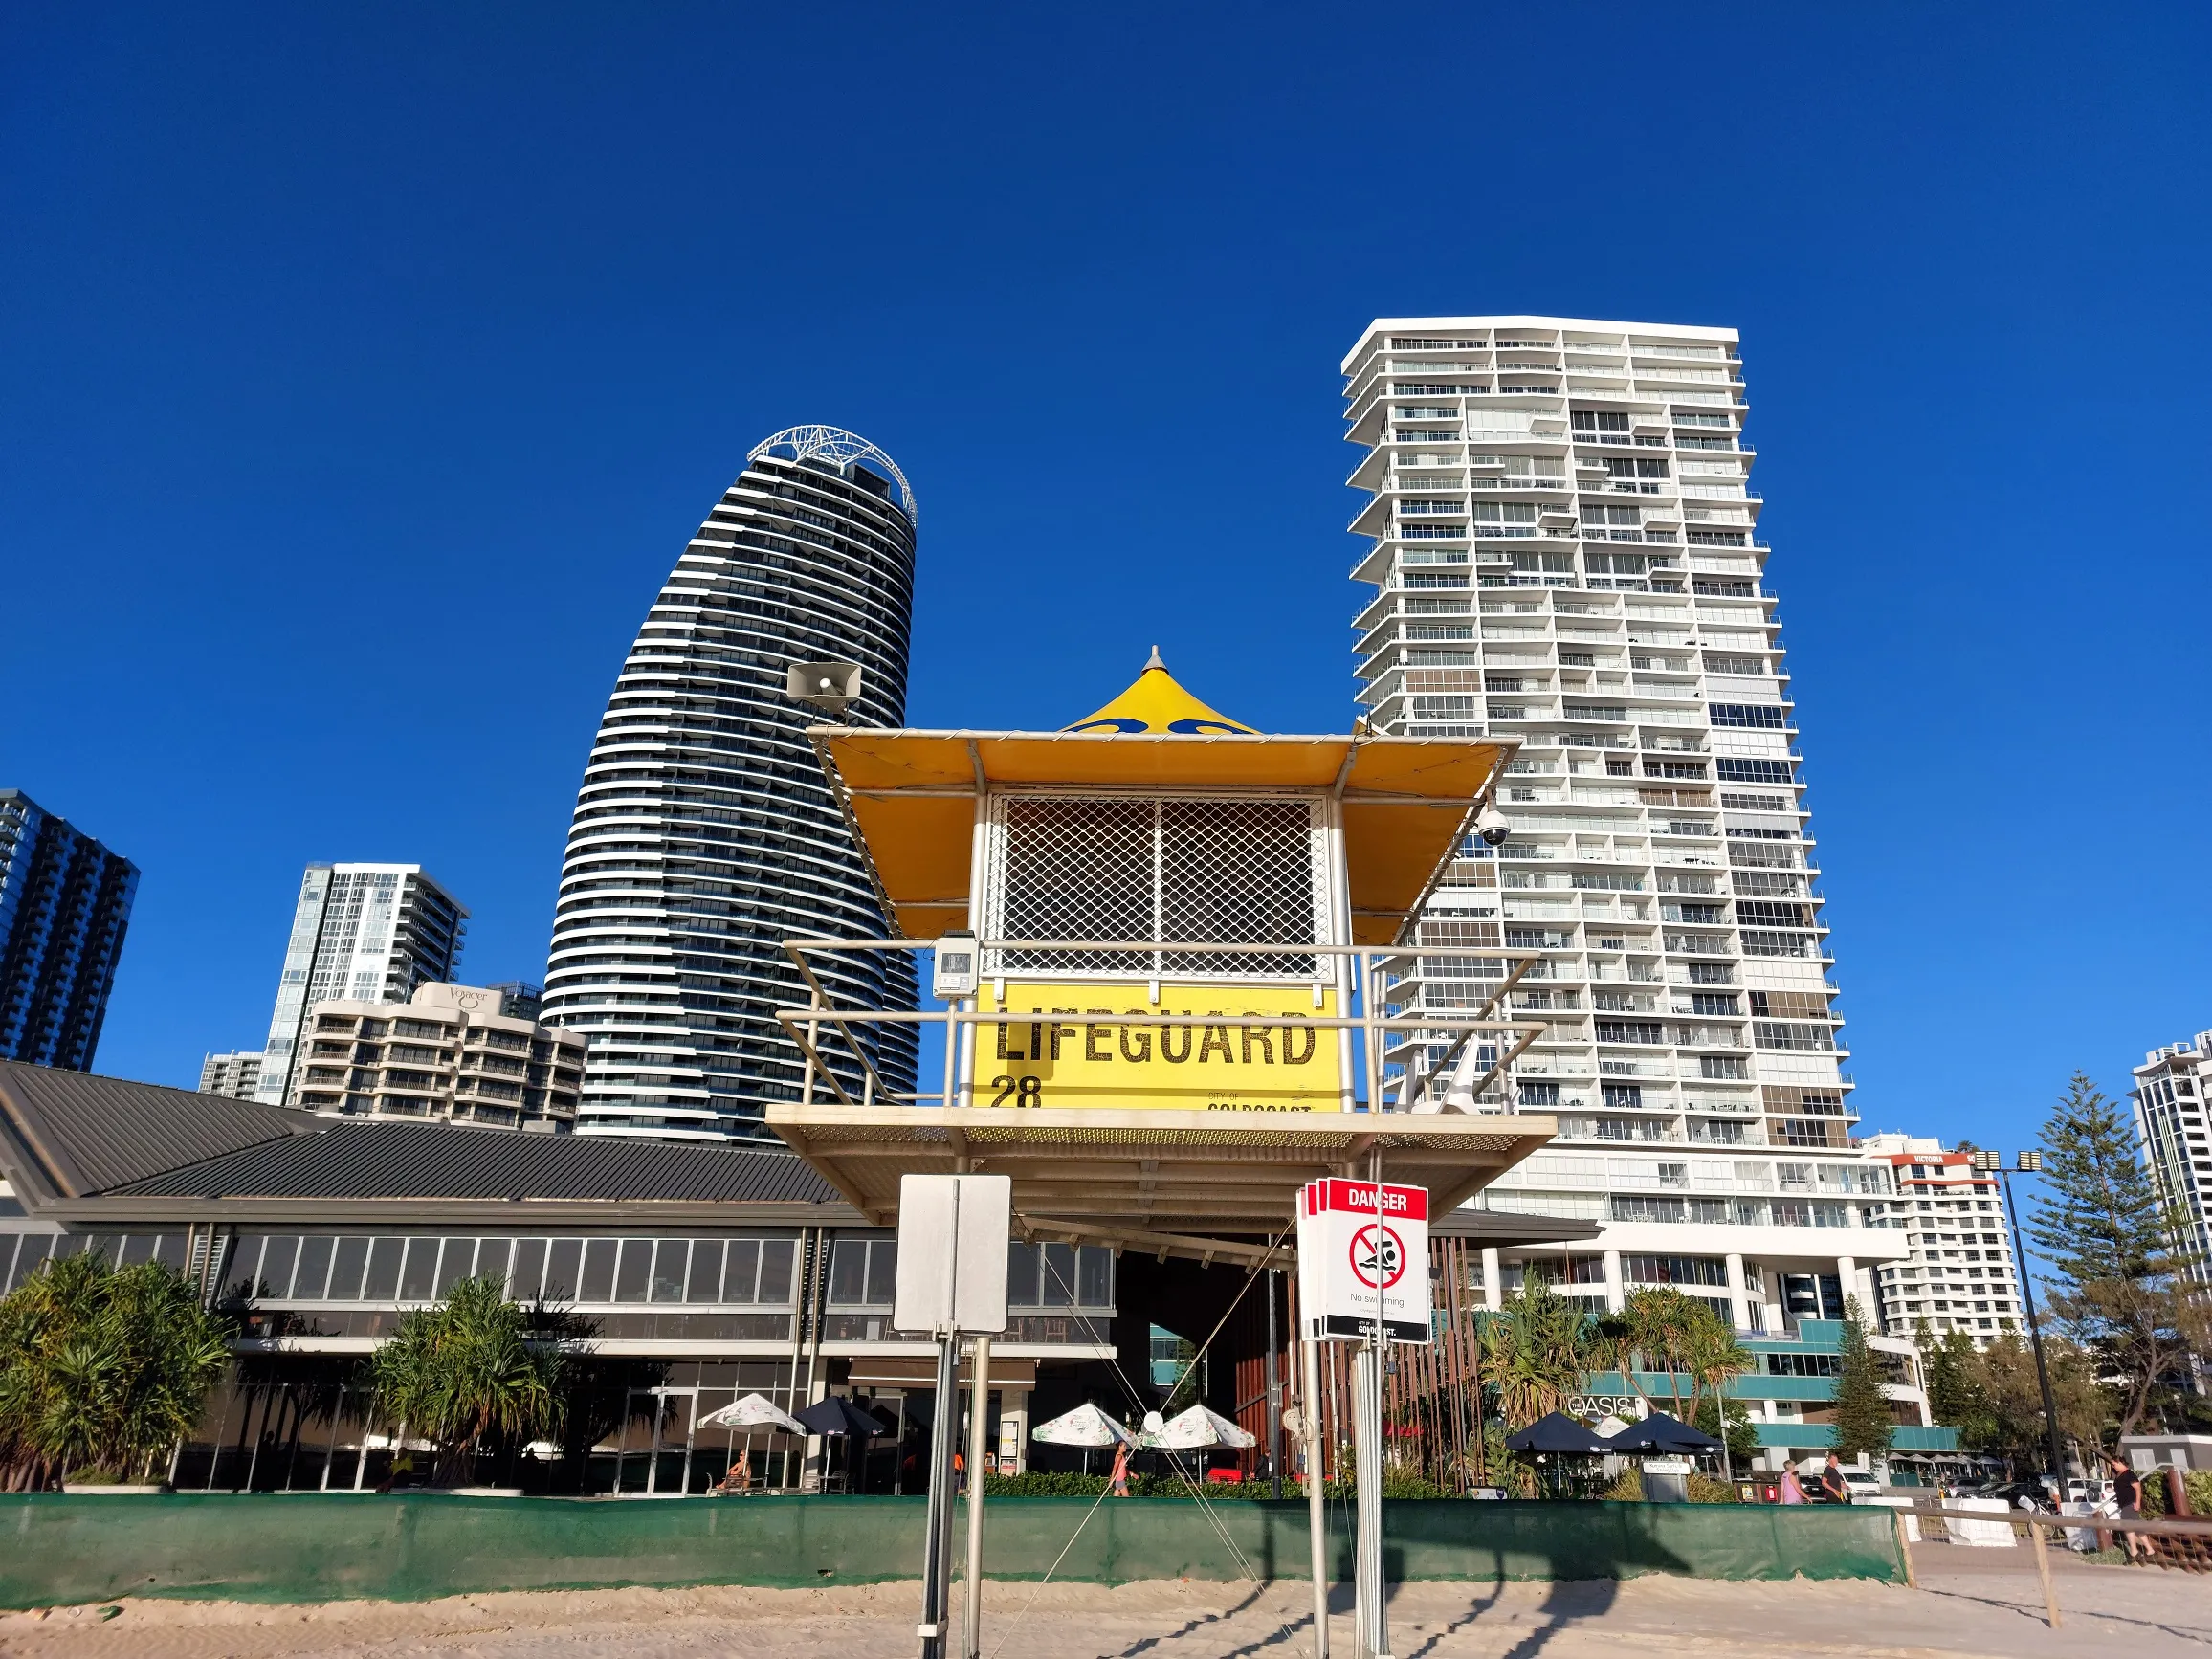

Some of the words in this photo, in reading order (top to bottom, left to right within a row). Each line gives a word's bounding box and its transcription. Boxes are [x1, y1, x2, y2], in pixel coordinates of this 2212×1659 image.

[450, 987, 488, 1009] Voyager
[996, 1007, 1316, 1065] LIFEGUARD
[991, 1075, 1042, 1108] 28
[1207, 1092, 1225, 1100] CITY
[1229, 1093, 1239, 1101] OF
[1914, 1155, 1943, 1163] VICTORIA
[1348, 1188, 1407, 1212] DANGER
[1350, 1294, 1362, 1302] No
[1568, 1396, 1630, 1416] OASIS
